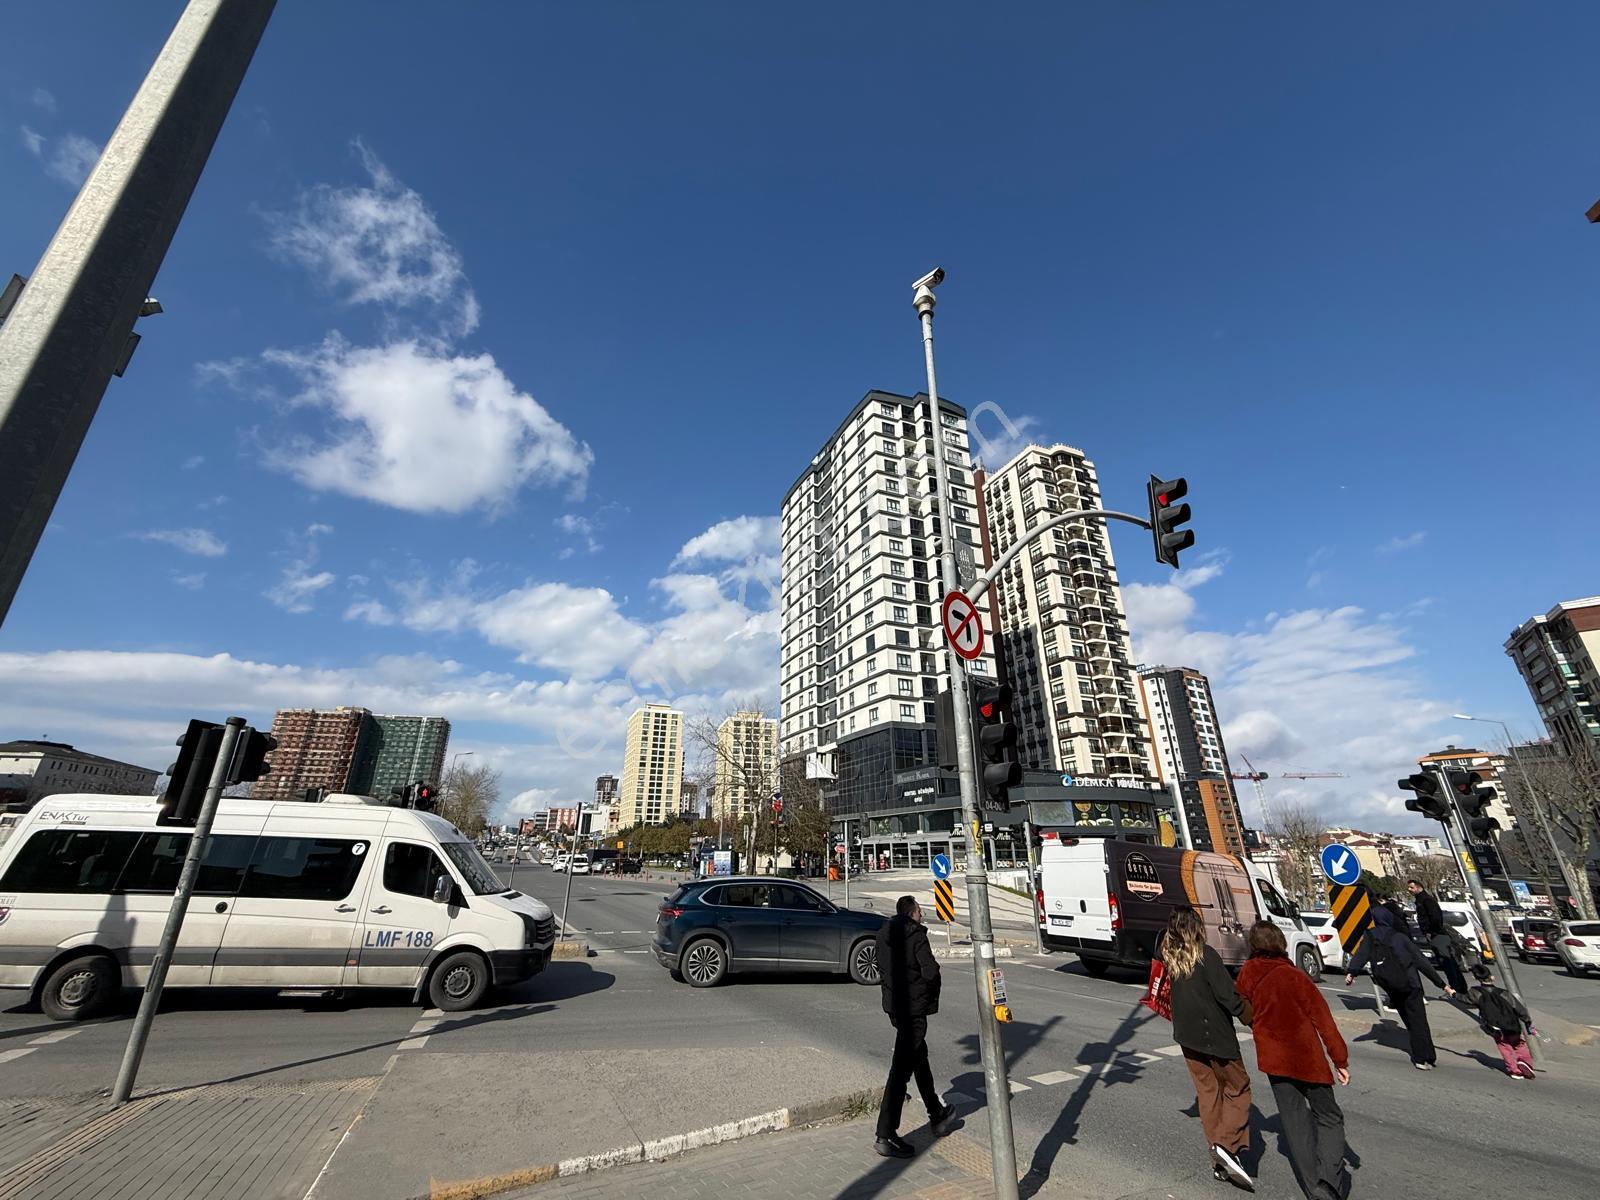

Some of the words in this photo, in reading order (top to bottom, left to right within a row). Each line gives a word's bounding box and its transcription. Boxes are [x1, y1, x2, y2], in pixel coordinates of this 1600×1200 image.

[355, 844, 362, 853] 7
[365, 931, 403, 947] LMF
[405, 931, 434, 947] 188
